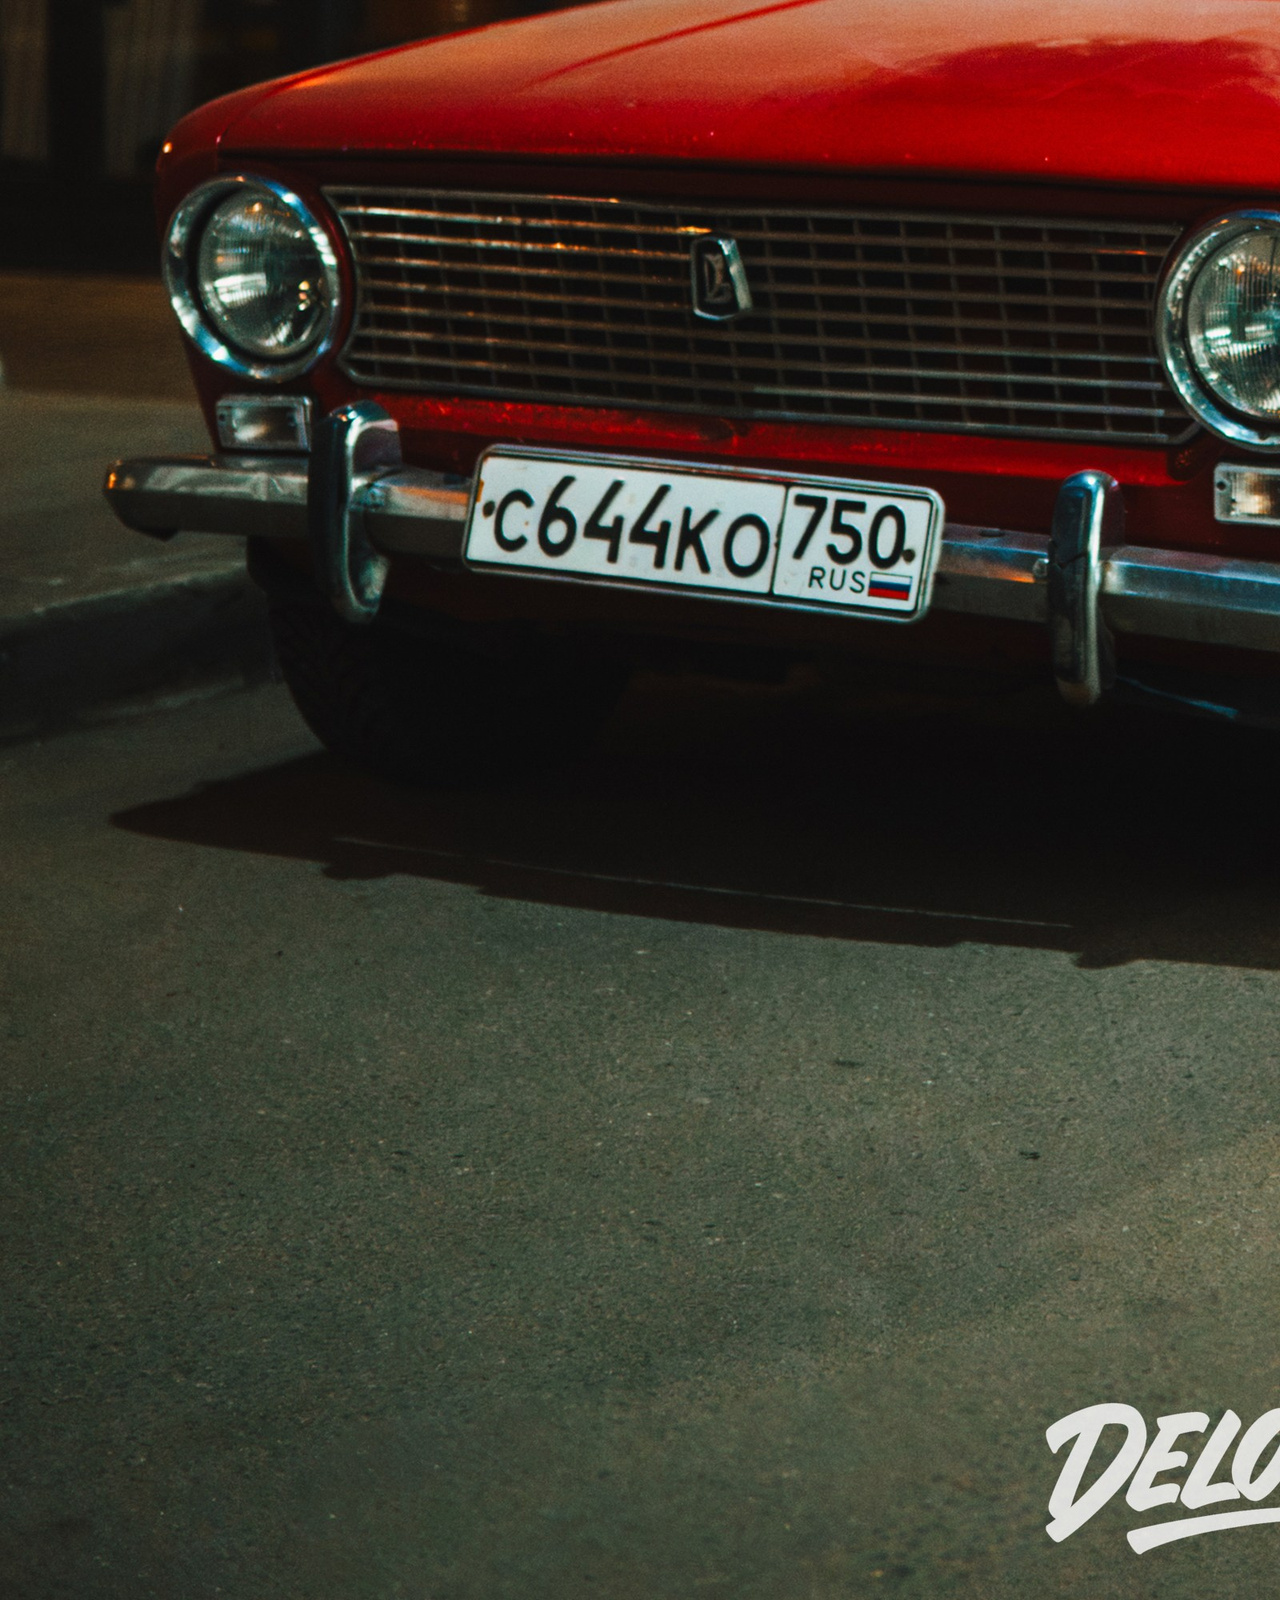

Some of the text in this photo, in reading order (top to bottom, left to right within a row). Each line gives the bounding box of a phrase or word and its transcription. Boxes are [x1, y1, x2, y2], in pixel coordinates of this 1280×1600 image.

[493, 475, 906, 579] С644КО 750
[807, 565, 867, 594] RUS
